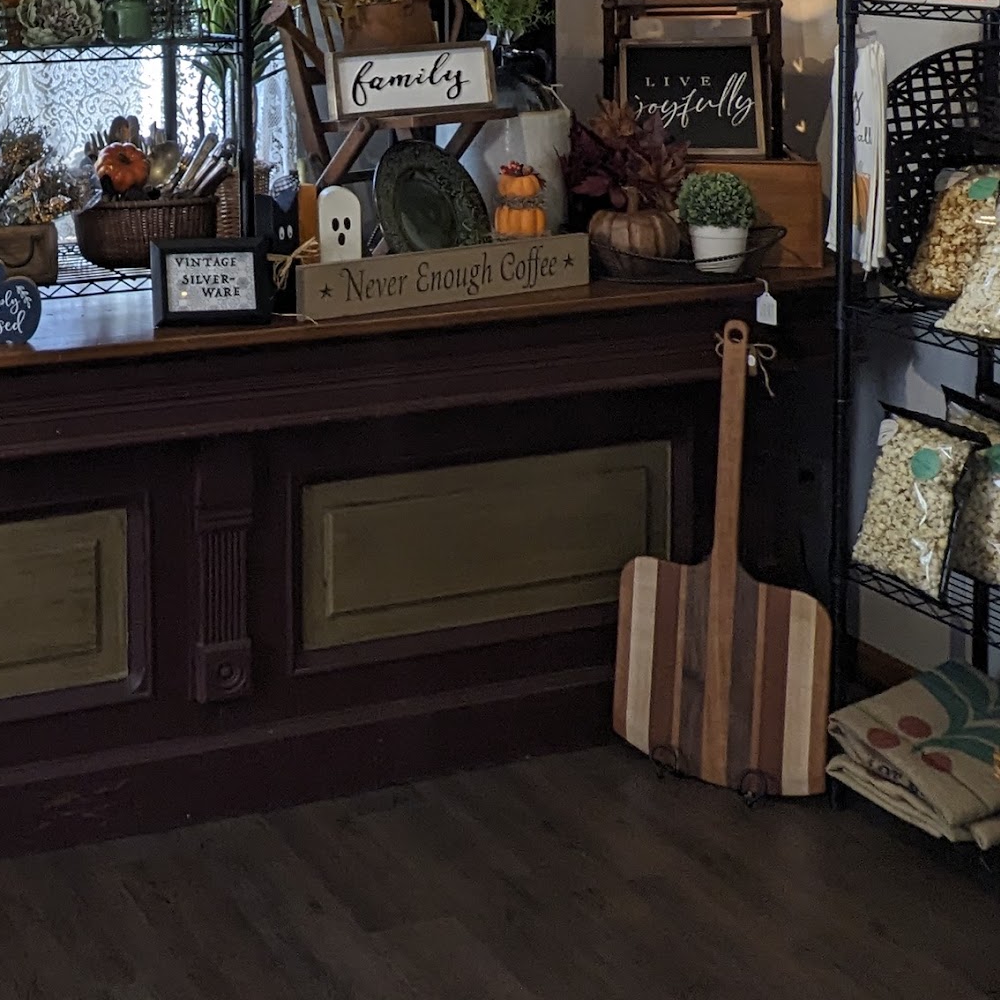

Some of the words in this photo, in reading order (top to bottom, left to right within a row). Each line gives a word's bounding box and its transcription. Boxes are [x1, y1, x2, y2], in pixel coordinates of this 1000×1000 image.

[352, 51, 470, 107] family
[645, 76, 713, 88] LIVE
[634, 71, 756, 129] joyfully
[175, 257, 237, 267] VINTAGE
[181, 274, 235, 285] SILVER-
[340, 267, 408, 302] Never
[416, 252, 493, 296] Enough
[500, 245, 558, 289] Coffee
[202, 287, 240, 298] WARE
